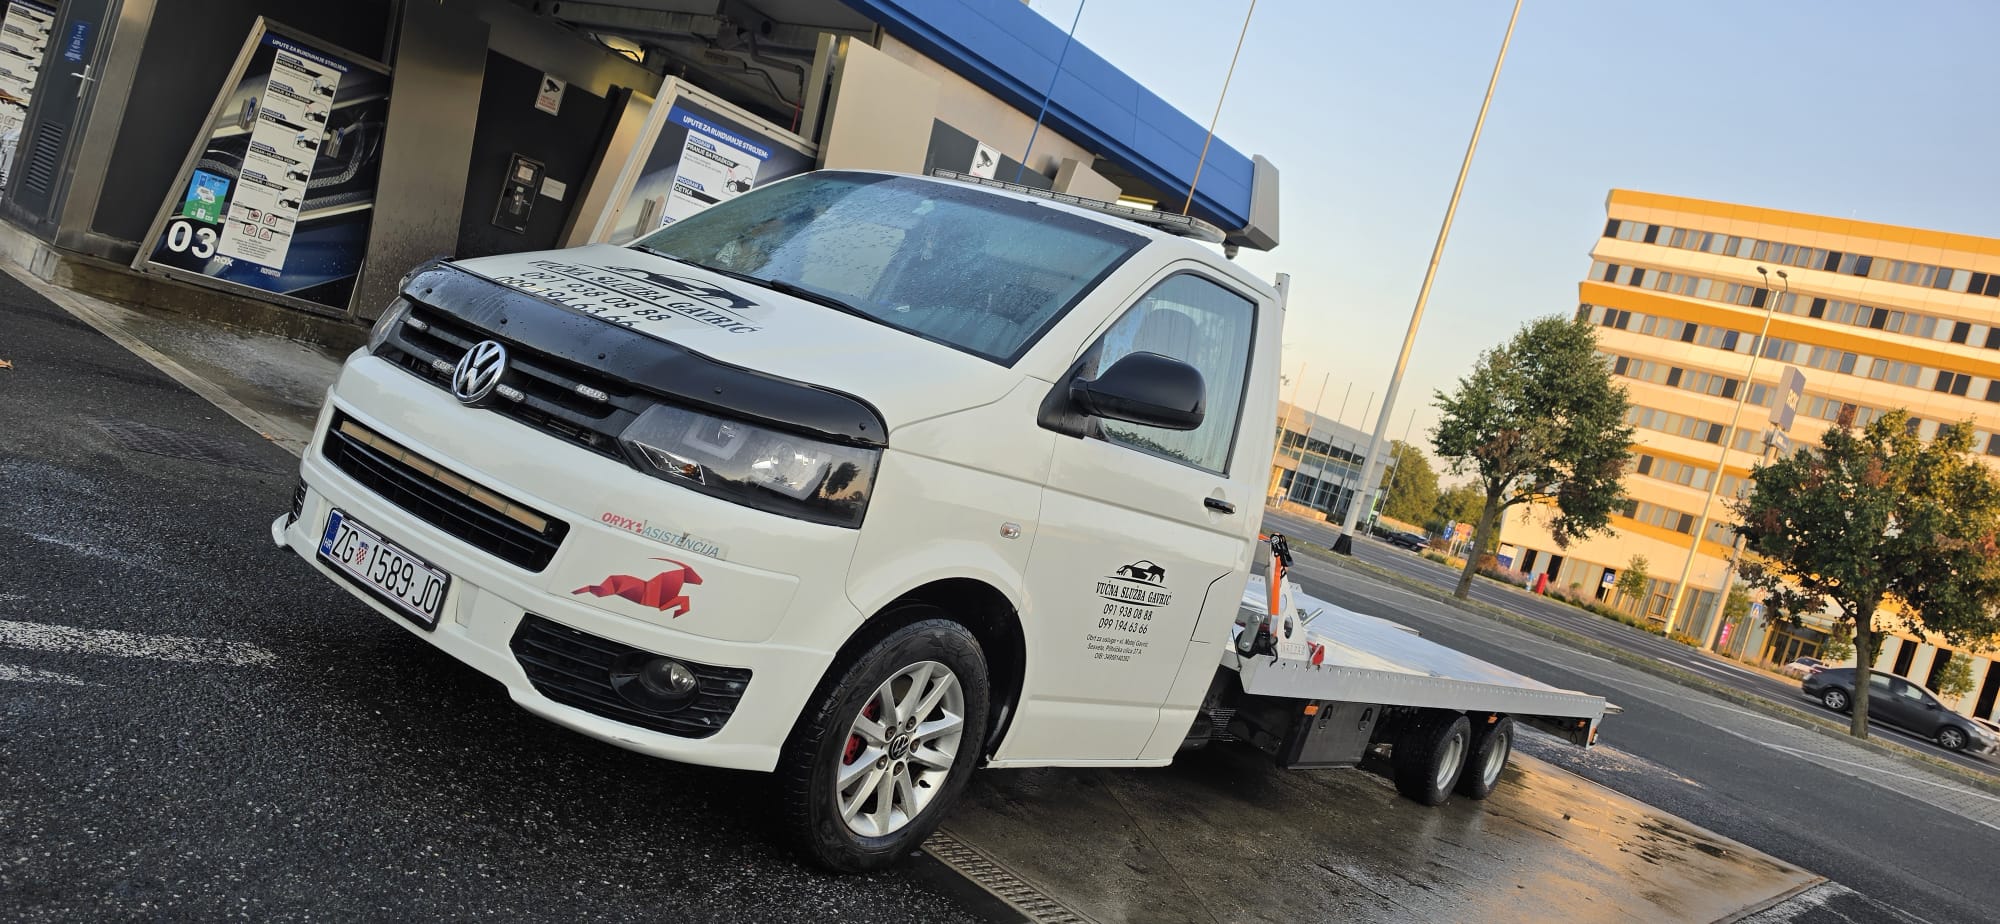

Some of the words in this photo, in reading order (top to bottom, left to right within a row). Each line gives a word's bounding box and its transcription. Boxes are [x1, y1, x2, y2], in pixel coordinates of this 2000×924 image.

[272, 39, 289, 50] UPUTE
[682, 115, 703, 129] UPUTE
[703, 122, 711, 133] ZA
[711, 127, 743, 147] RUKOVANJE
[742, 140, 769, 159] STROJEM:
[686, 142, 705, 155] PRANJE
[689, 135, 710, 148] PROGRAM
[674, 182, 693, 196] ČETKA
[167, 220, 217, 259] 03
[521, 271, 566, 284] 091
[560, 283, 609, 298] 938
[600, 297, 639, 309] 08
[633, 309, 673, 322] 88
[588, 275, 670, 301] SLUŽBA
[667, 302, 763, 334] GAVRIĆ
[332, 523, 359, 563] ZG
[602, 512, 636, 531] ORYX
[642, 526, 719, 558] ASISTENCIJA
[1096, 580, 1119, 597] VUČNA
[1120, 585, 1146, 602] SLUŽBA
[1147, 592, 1173, 606] GAVRIĆ
[1103, 603, 1118, 616] 091
[1119, 606, 1133, 618] 938
[1133, 608, 1143, 619] 08
[1143, 610, 1153, 621] 88
[1098, 617, 1114, 629] 099
[1114, 619, 1128, 631] 194
[1128, 622, 1138, 632] 63
[1138, 624, 1148, 634] 66
